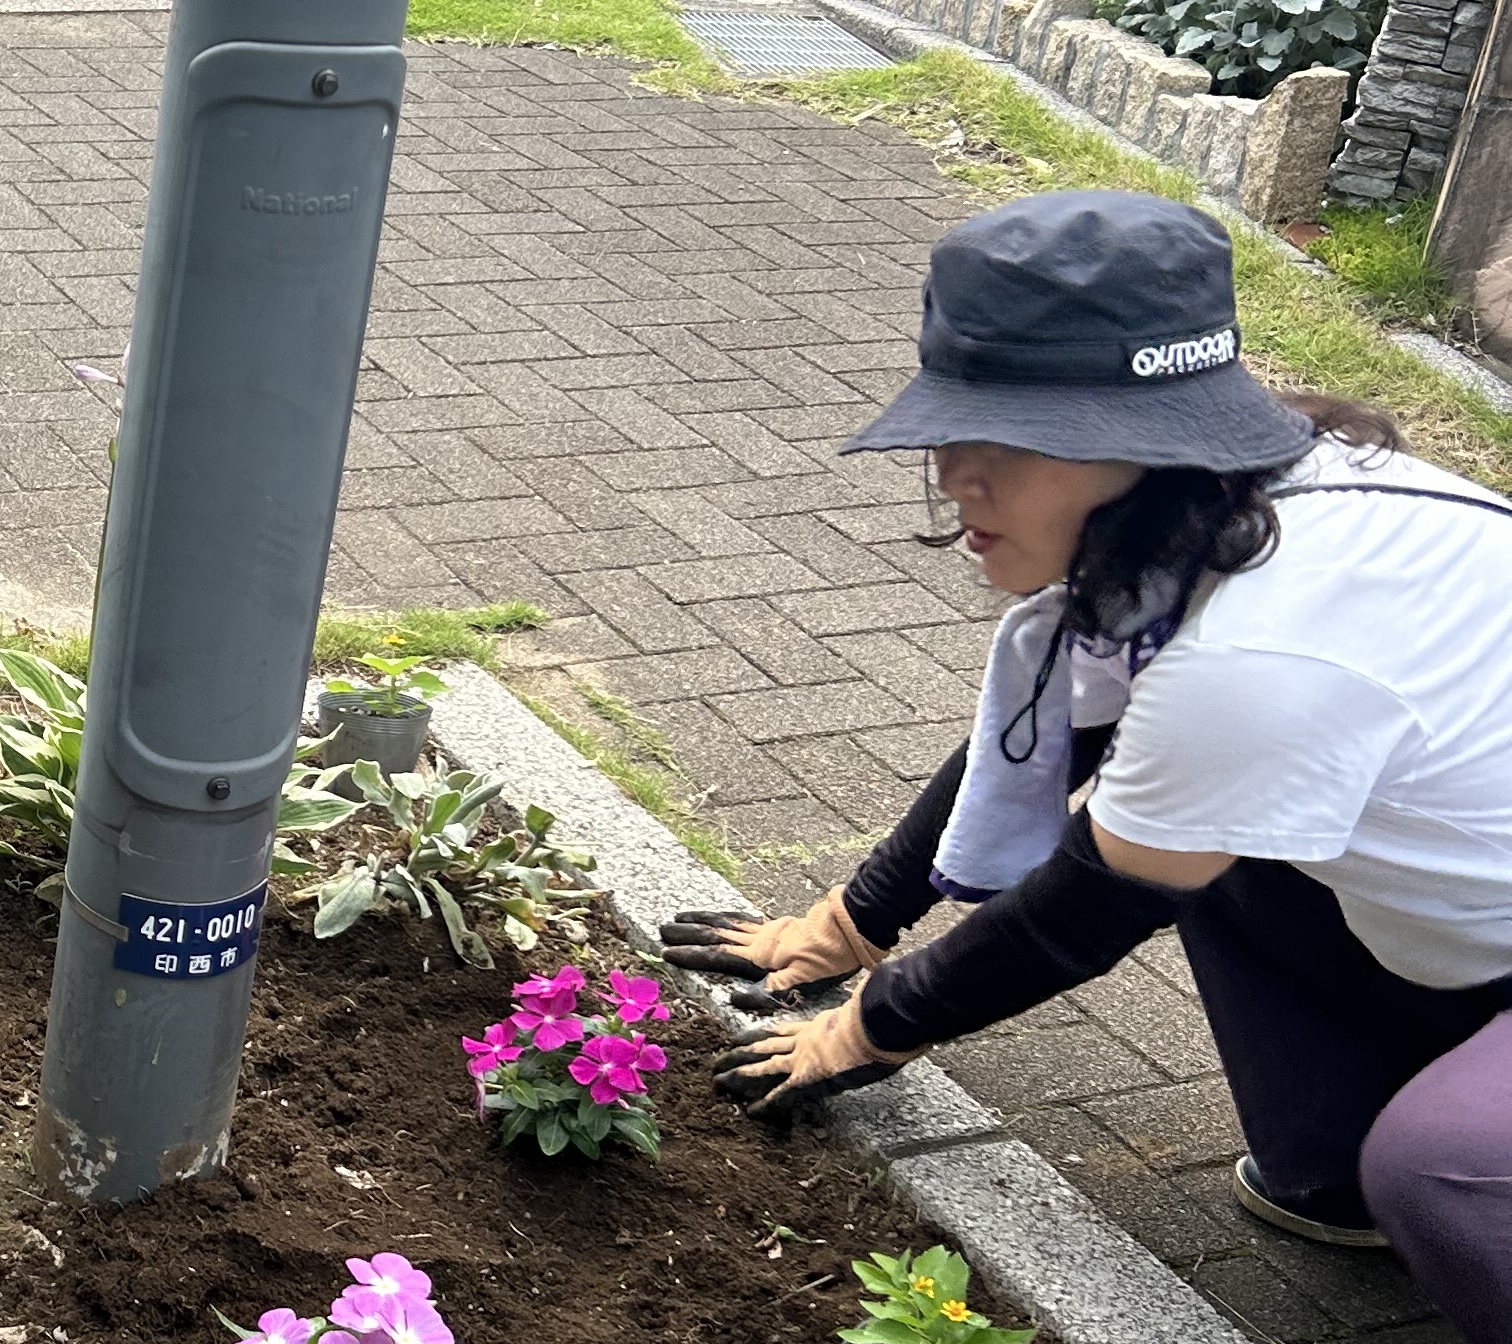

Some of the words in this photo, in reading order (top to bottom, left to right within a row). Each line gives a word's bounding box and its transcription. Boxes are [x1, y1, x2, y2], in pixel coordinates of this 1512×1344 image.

[240, 185, 358, 216] National
[141, 904, 255, 943] 421-0010
[154, 947, 237, 974] 印西市
